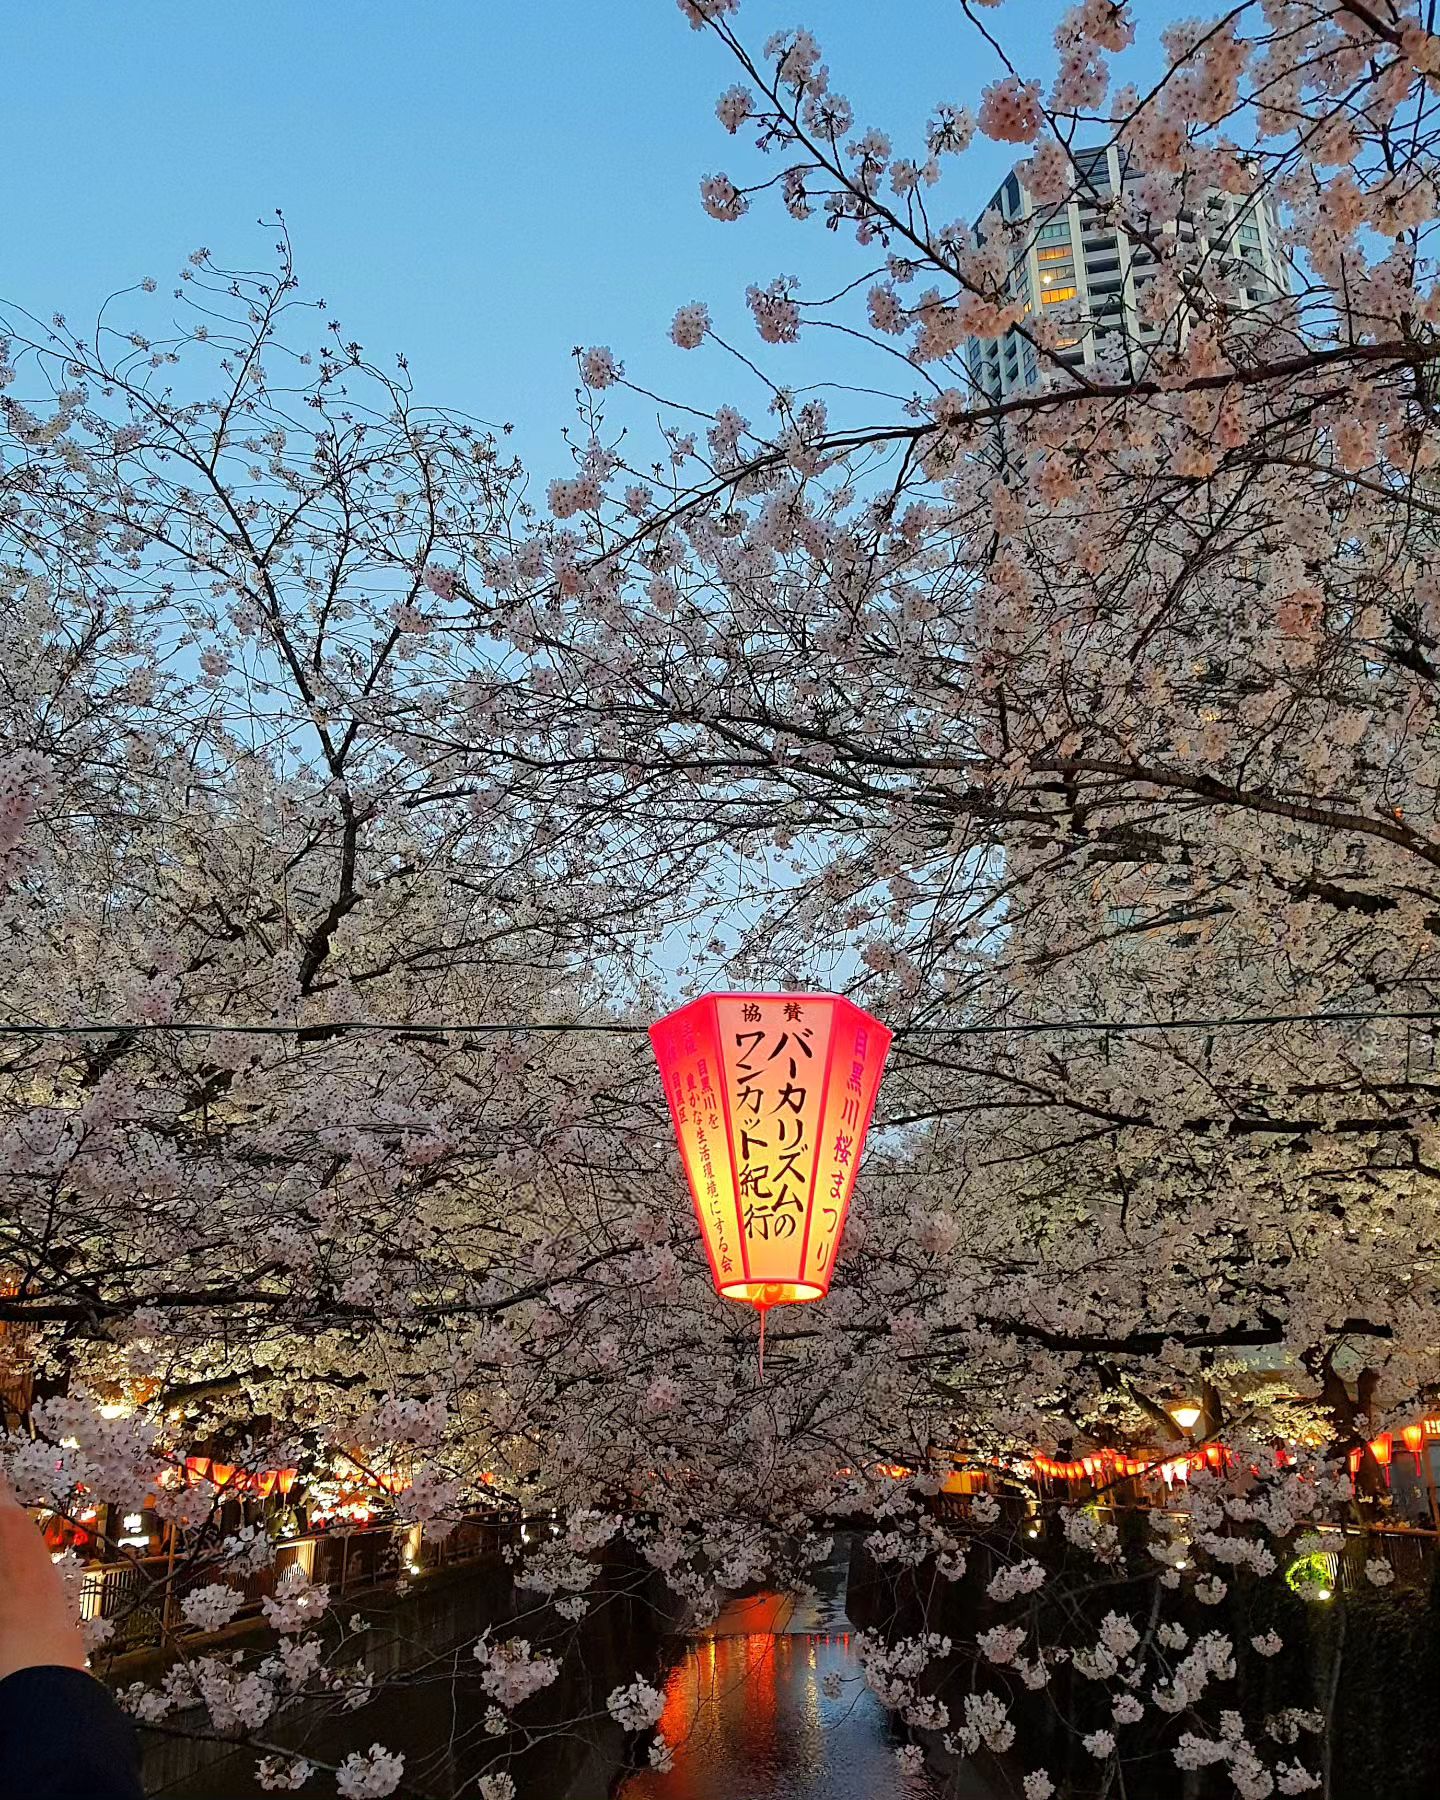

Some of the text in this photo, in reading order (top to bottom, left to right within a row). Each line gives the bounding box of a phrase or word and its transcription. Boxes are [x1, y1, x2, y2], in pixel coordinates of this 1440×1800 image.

[697, 1058, 719, 1130] 目黒川を
[735, 1030, 774, 1240] ワンカット紀行
[767, 1028, 814, 1239] バーカリズムの
[817, 1030, 869, 1273] 目黒川桜まつり
